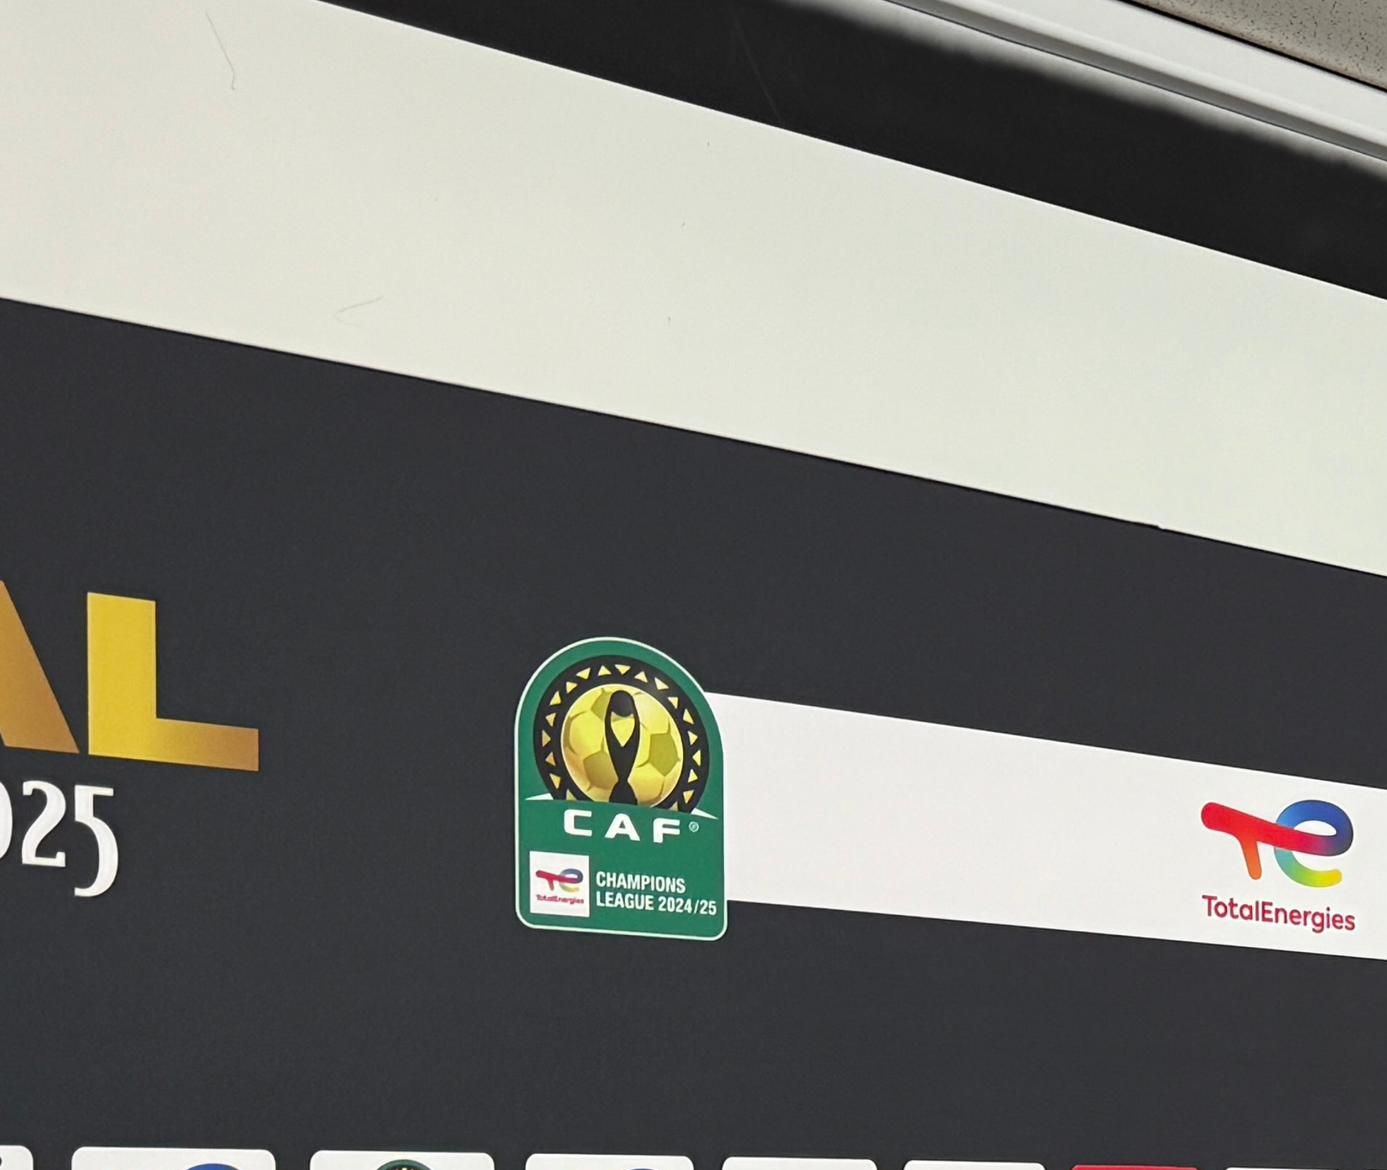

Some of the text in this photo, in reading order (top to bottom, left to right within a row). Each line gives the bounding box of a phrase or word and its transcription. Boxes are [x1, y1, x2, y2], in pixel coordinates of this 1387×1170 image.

[0, 780, 118, 897] 25
[564, 809, 680, 843] CAF
[596, 871, 685, 894] CHAMPIONS
[597, 891, 716, 915] LEAGUE 2024/25
[1202, 895, 1355, 933] TotalEnergies
